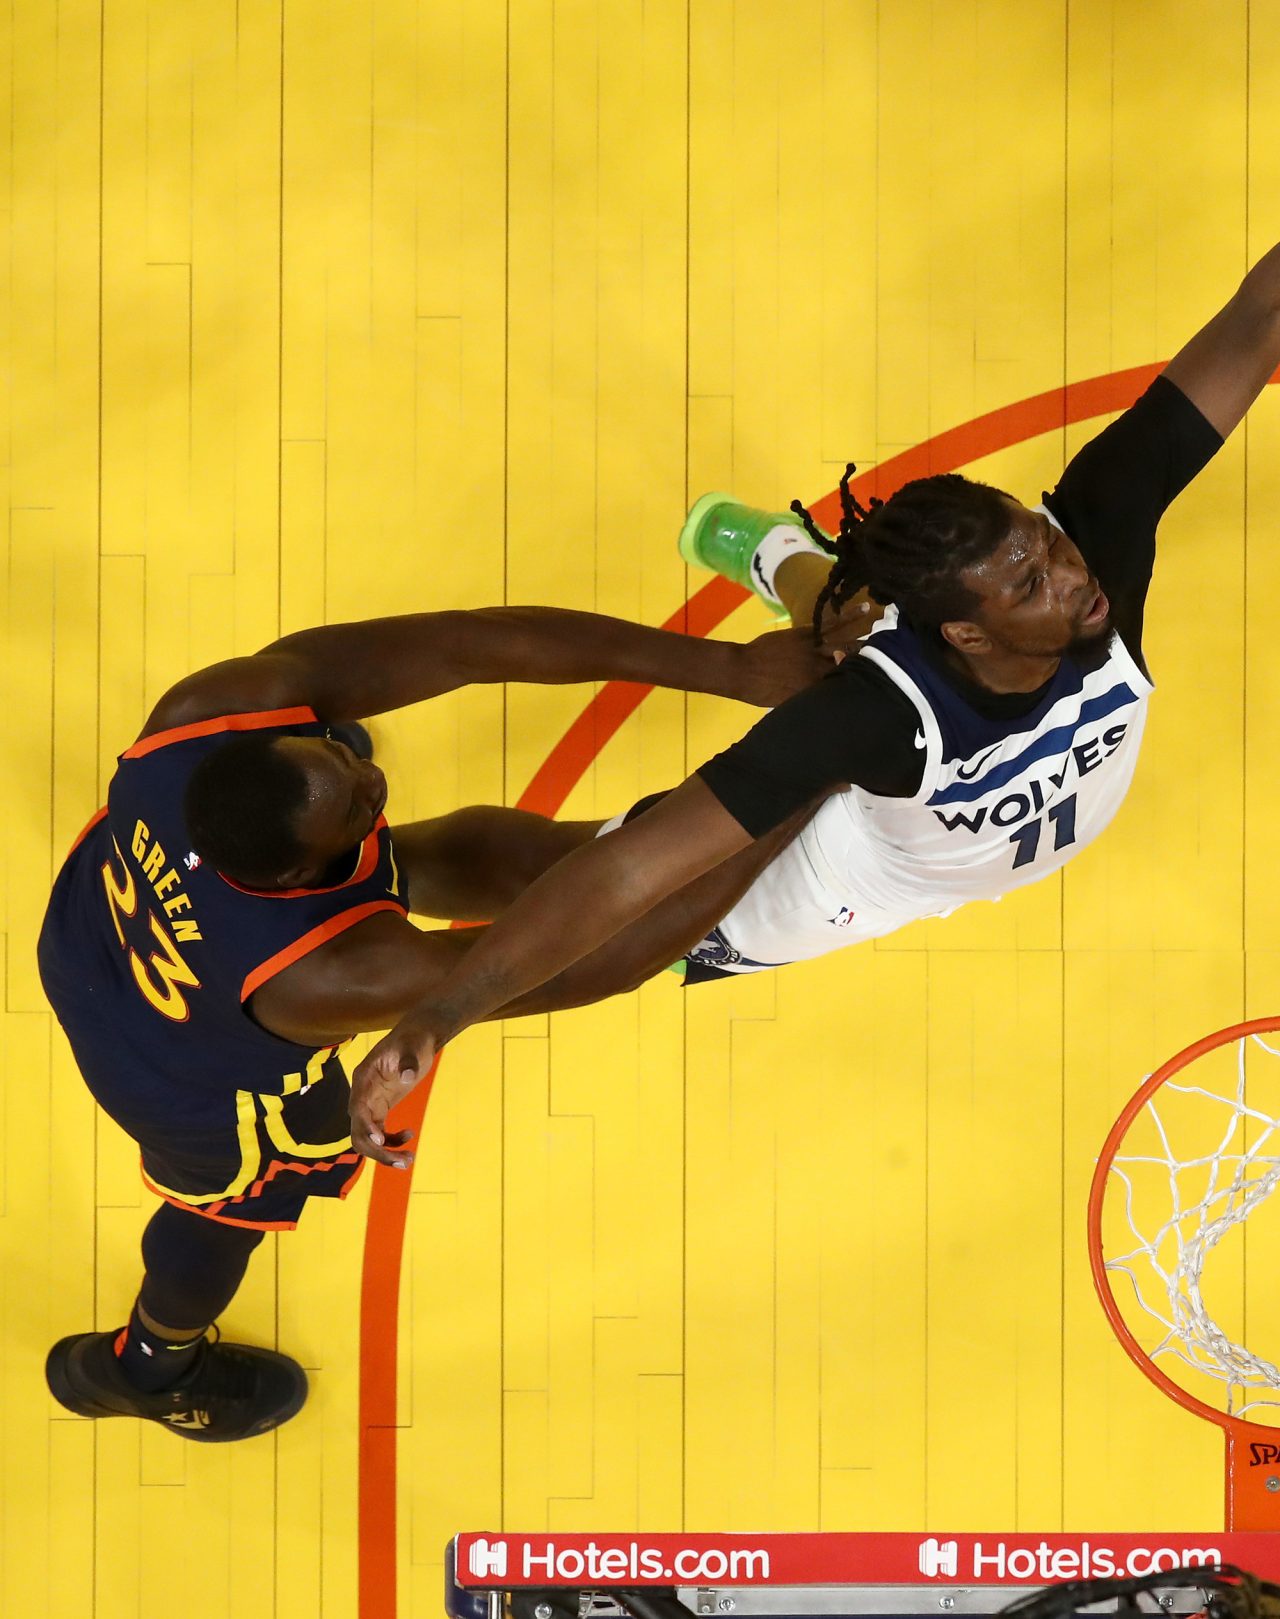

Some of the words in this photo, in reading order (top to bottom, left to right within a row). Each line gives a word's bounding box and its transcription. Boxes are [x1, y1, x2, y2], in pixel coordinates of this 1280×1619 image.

[933, 724, 1128, 834] WOLVES
[1009, 792, 1077, 869] 11
[101, 832, 202, 1023] 23
[131, 819, 203, 943] GREEN
[523, 1541, 770, 1579] Hotels.com
[973, 1541, 1222, 1578] Hotels.com
